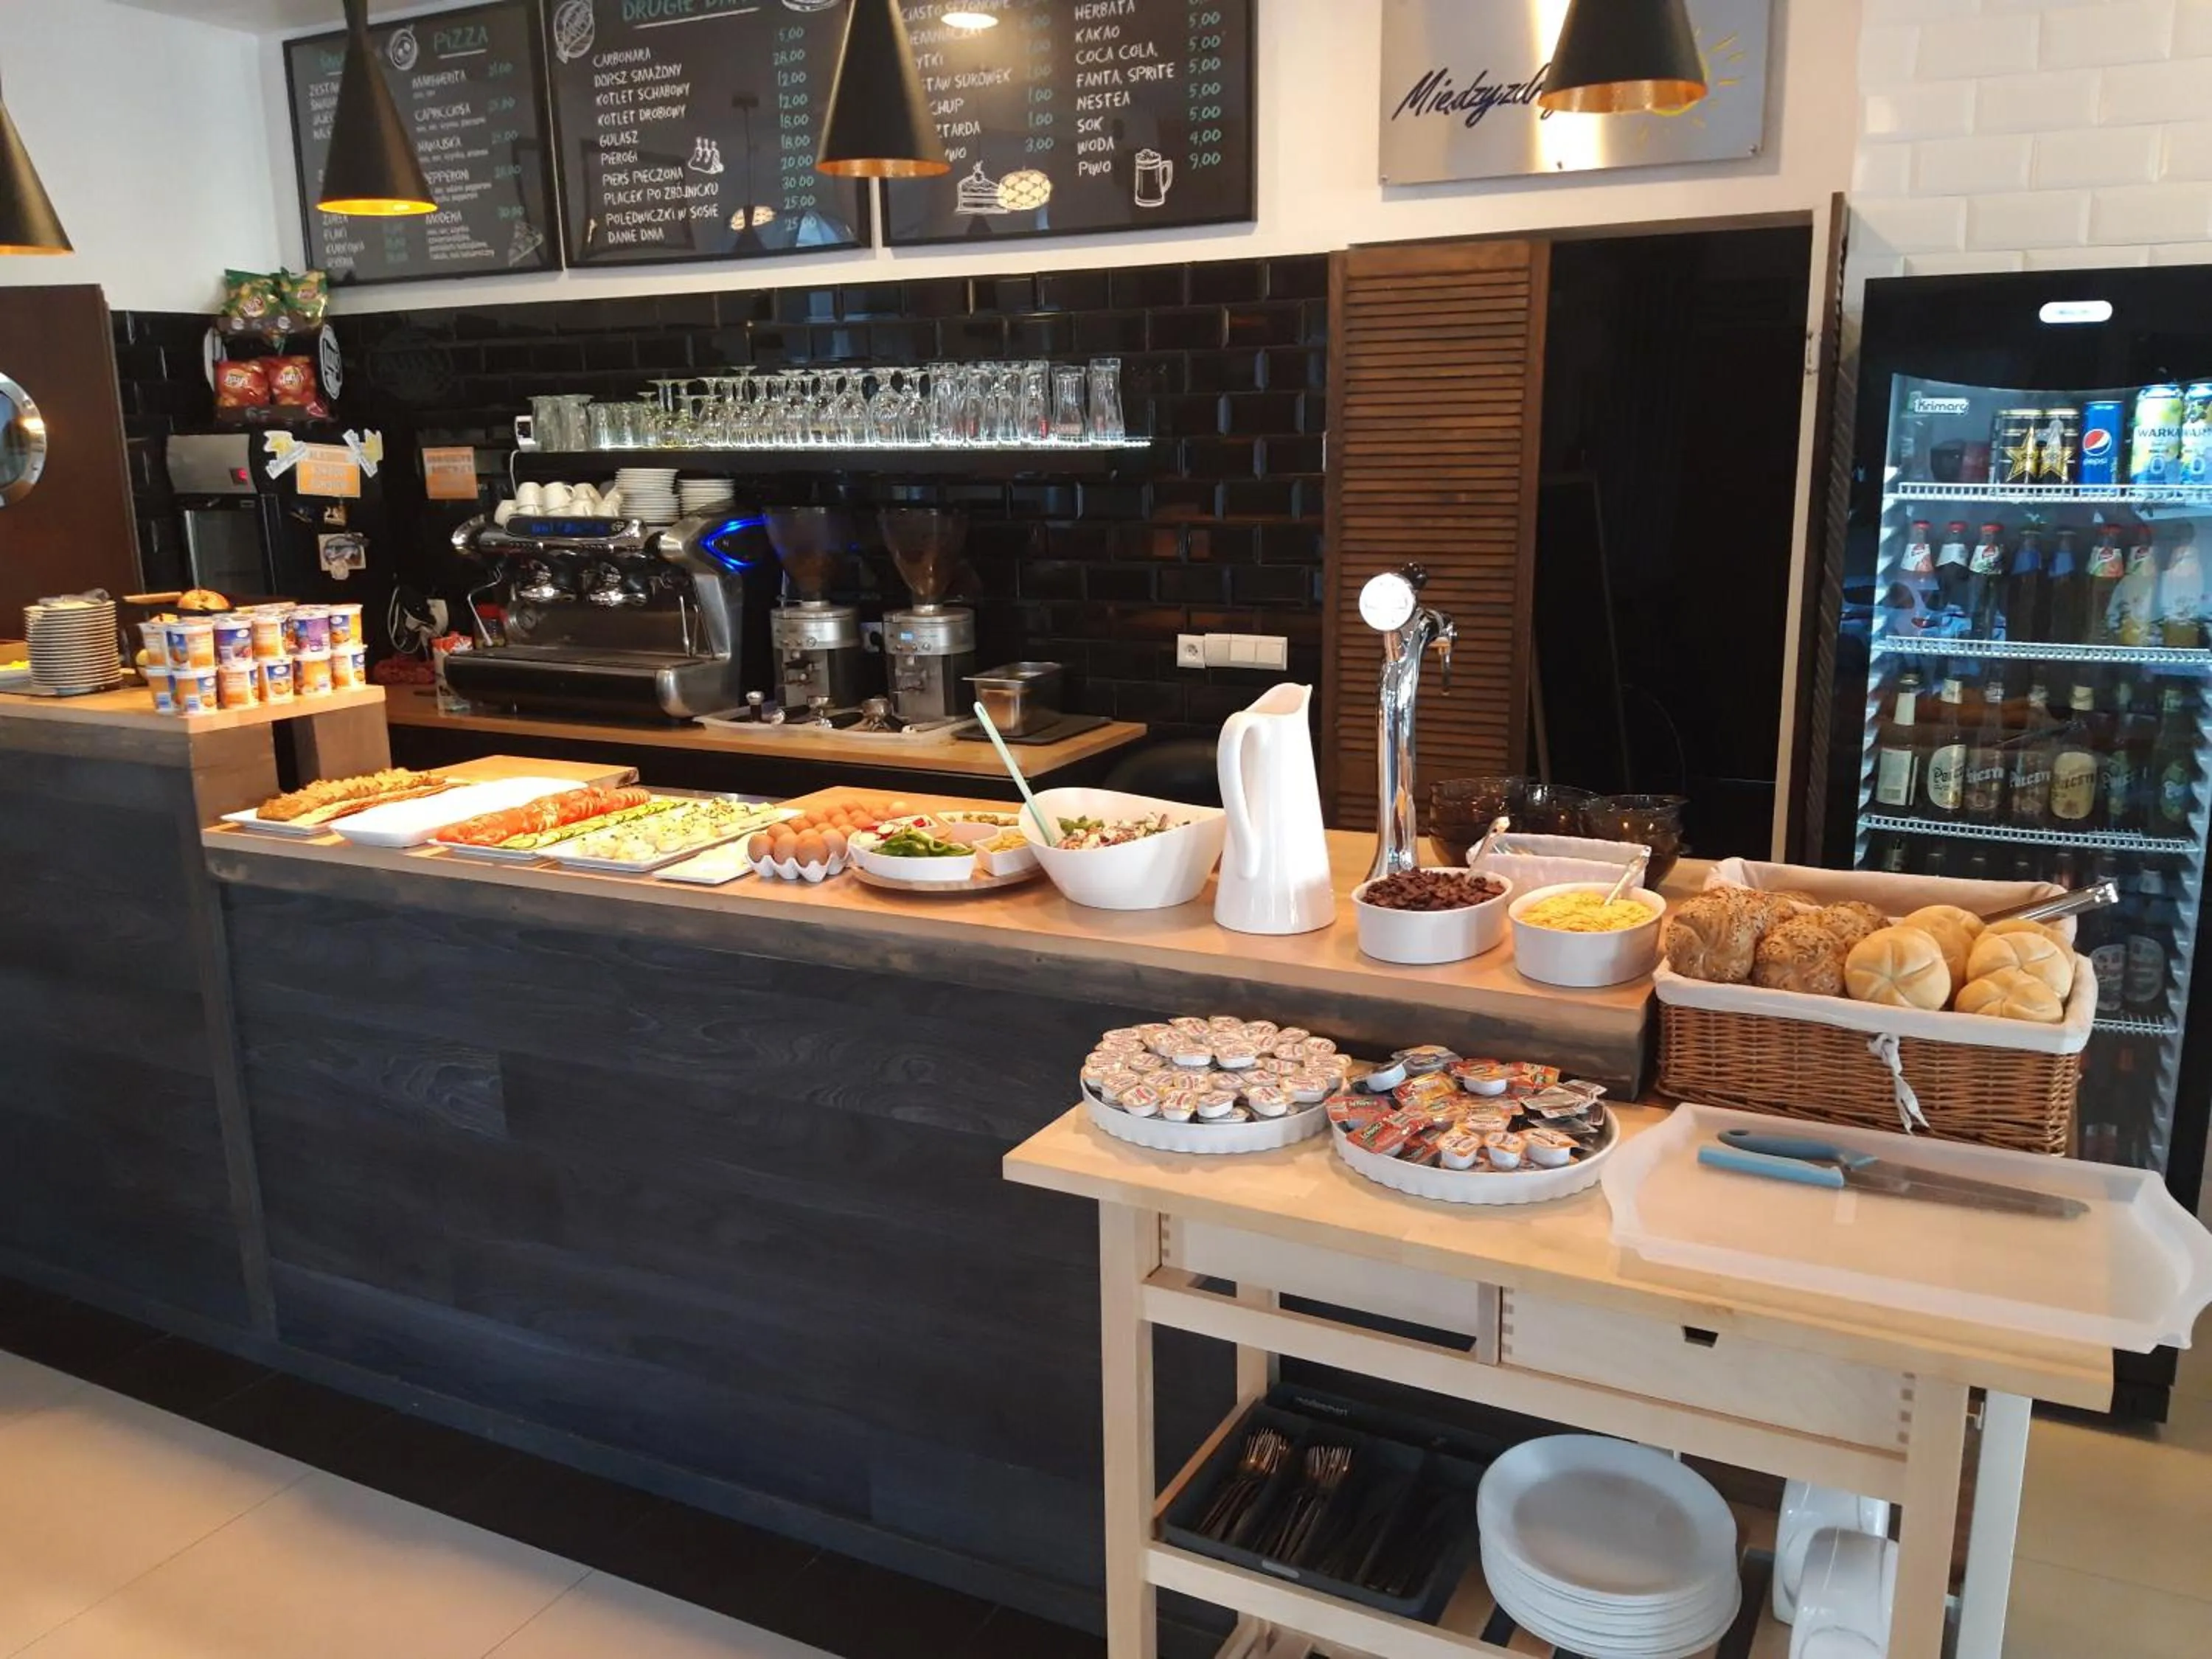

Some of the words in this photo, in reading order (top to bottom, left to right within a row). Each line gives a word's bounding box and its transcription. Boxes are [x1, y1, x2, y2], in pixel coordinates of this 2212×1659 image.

[1074, 0, 1135, 21] HERBATA
[434, 26, 489, 52] PIZZA
[1075, 25, 1121, 44] KAKAO
[593, 47, 651, 67] CARBONARA
[1076, 46, 1114, 65] COCA
[594, 71, 628, 87] DORSZ
[1127, 62, 1175, 83] SPRITE
[596, 89, 633, 105] KOTLET
[638, 83, 690, 101] SCHABOWY
[1077, 91, 1131, 111] NESTEA
[598, 110, 635, 127] KOTLET
[1077, 116, 1105, 133] SOK
[599, 130, 639, 147] GULASZ
[1077, 136, 1116, 155] WODA
[601, 150, 638, 165] PIEROGI
[633, 167, 684, 183] PIECZONA
[1079, 160, 1112, 177] PIWO
[604, 189, 644, 206] PLACEK
[647, 189, 662, 201] PO
[678, 208, 686, 220] W
[689, 204, 720, 219] SOSIE
[608, 229, 637, 244] DANIE
